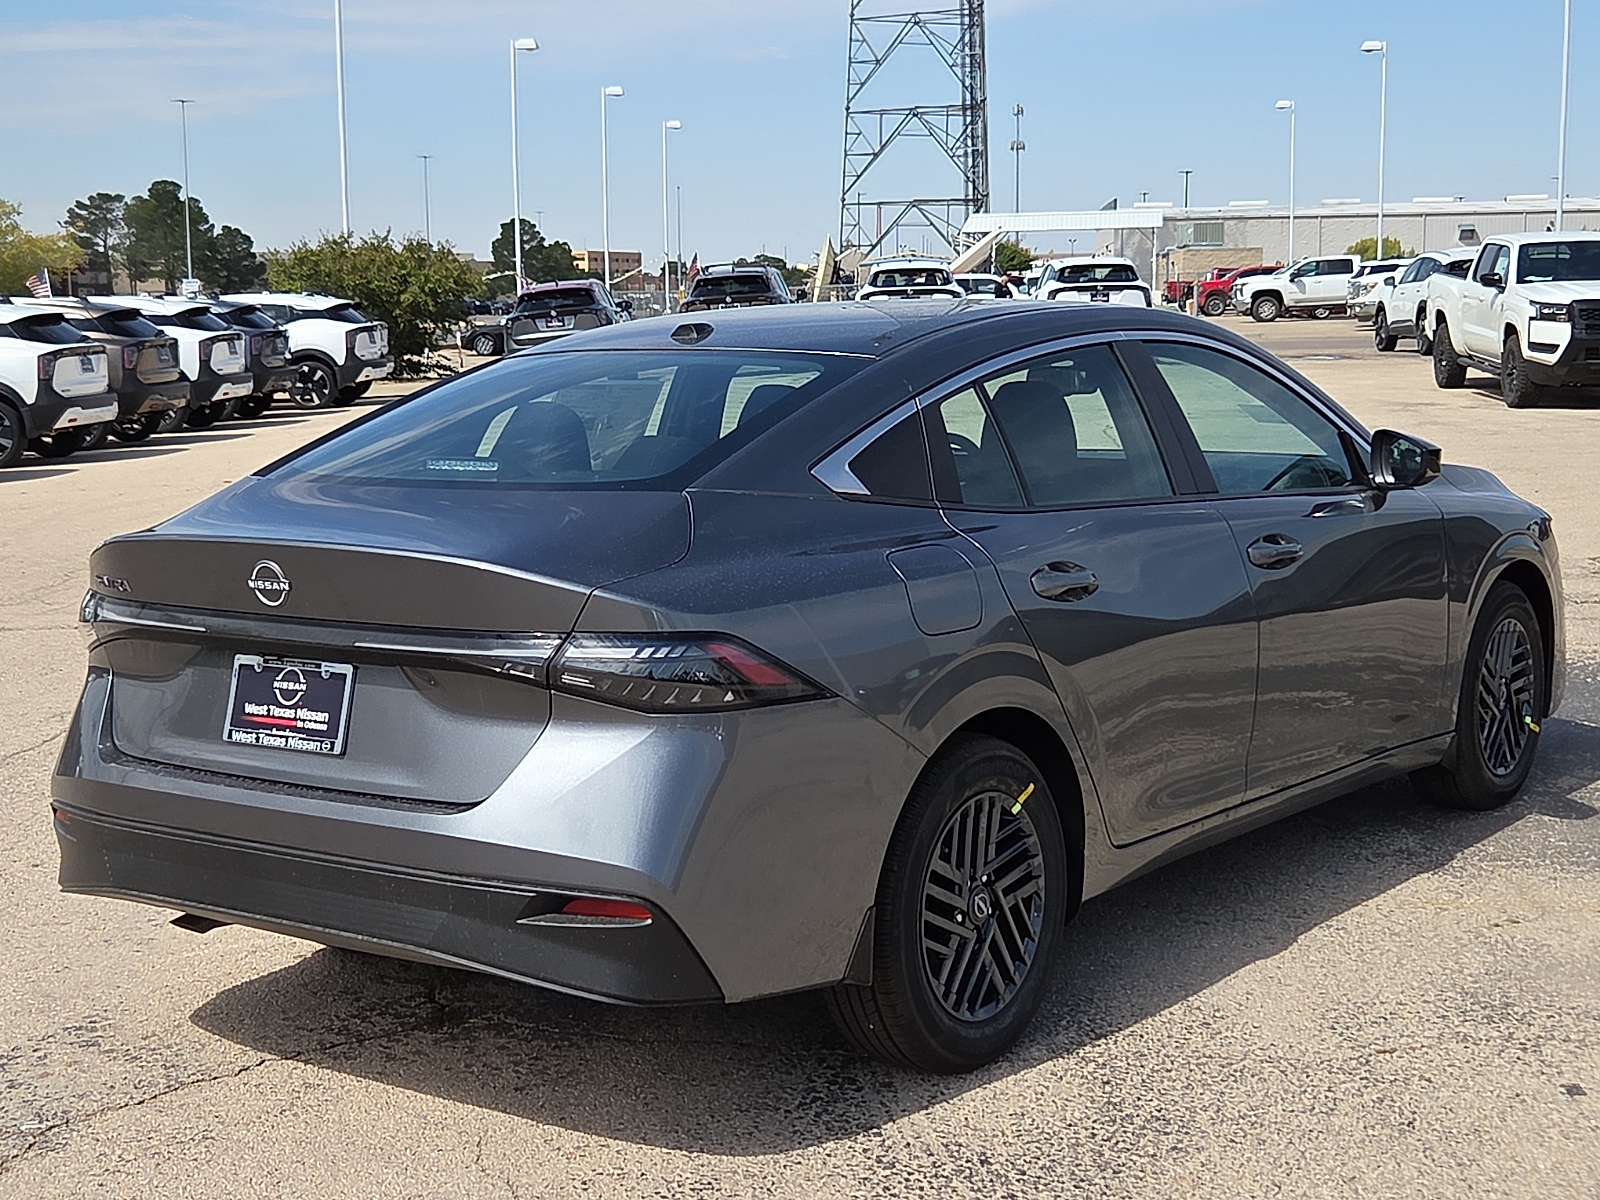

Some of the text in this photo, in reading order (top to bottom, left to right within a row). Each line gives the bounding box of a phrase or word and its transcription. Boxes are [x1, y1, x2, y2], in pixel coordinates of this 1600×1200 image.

[248, 578, 290, 591] NISSAN
[273, 681, 307, 691] NISSAN
[244, 702, 329, 722] West Texas Nissan
[231, 730, 257, 743] West
[258, 733, 286, 747] Texas
[287, 737, 321, 751] Nissan
